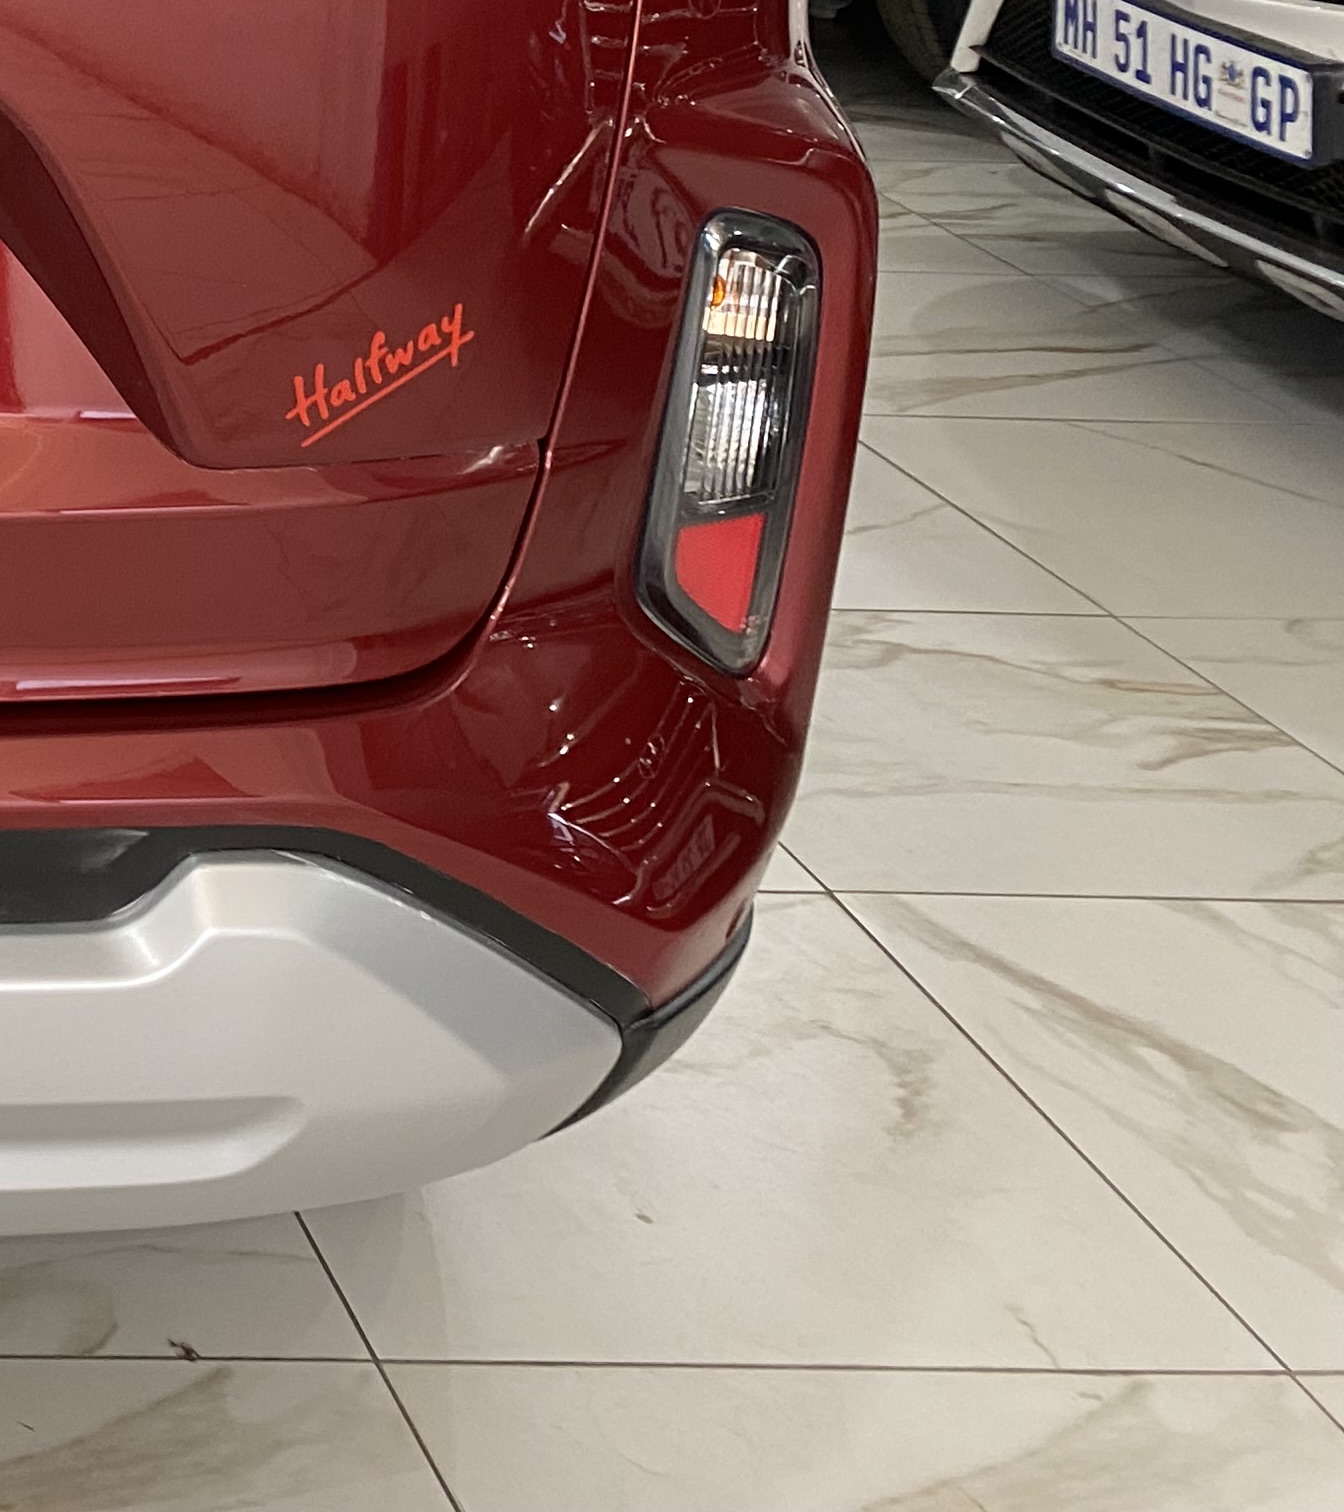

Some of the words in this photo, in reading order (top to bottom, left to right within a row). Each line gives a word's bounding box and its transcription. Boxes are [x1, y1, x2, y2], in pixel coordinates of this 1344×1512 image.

[1114, 9, 1152, 85] 51
[1170, 33, 1212, 111] HG
[1251, 65, 1300, 142] GP
[285, 303, 470, 430] Halfway
